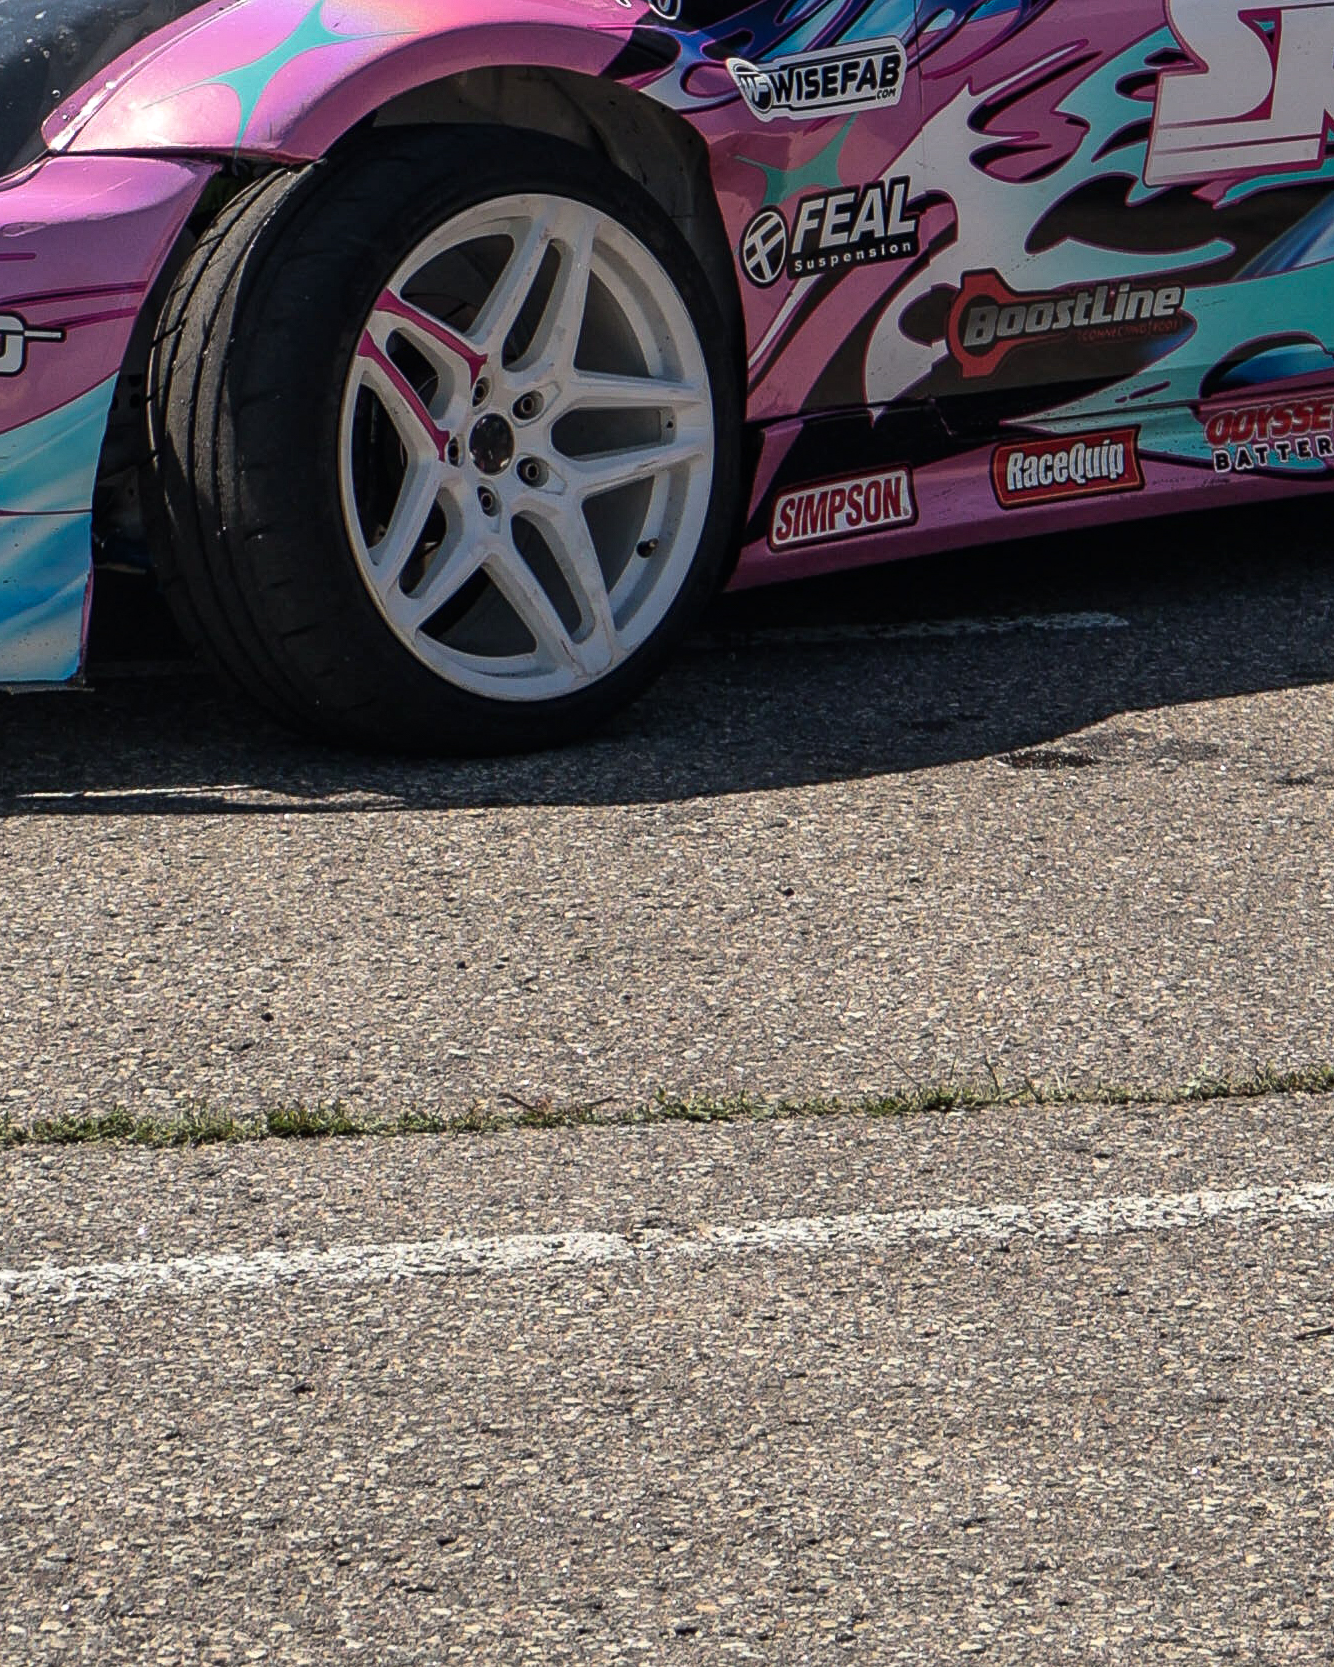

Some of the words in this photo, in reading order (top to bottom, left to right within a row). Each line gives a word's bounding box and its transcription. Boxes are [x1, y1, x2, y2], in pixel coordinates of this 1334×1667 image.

[769, 53, 902, 103] WISEFAB
[791, 182, 916, 255] FEAL
[794, 241, 912, 272] Suspension
[1007, 438, 1126, 492] RaceQuip
[774, 476, 904, 541] SIMPSON
